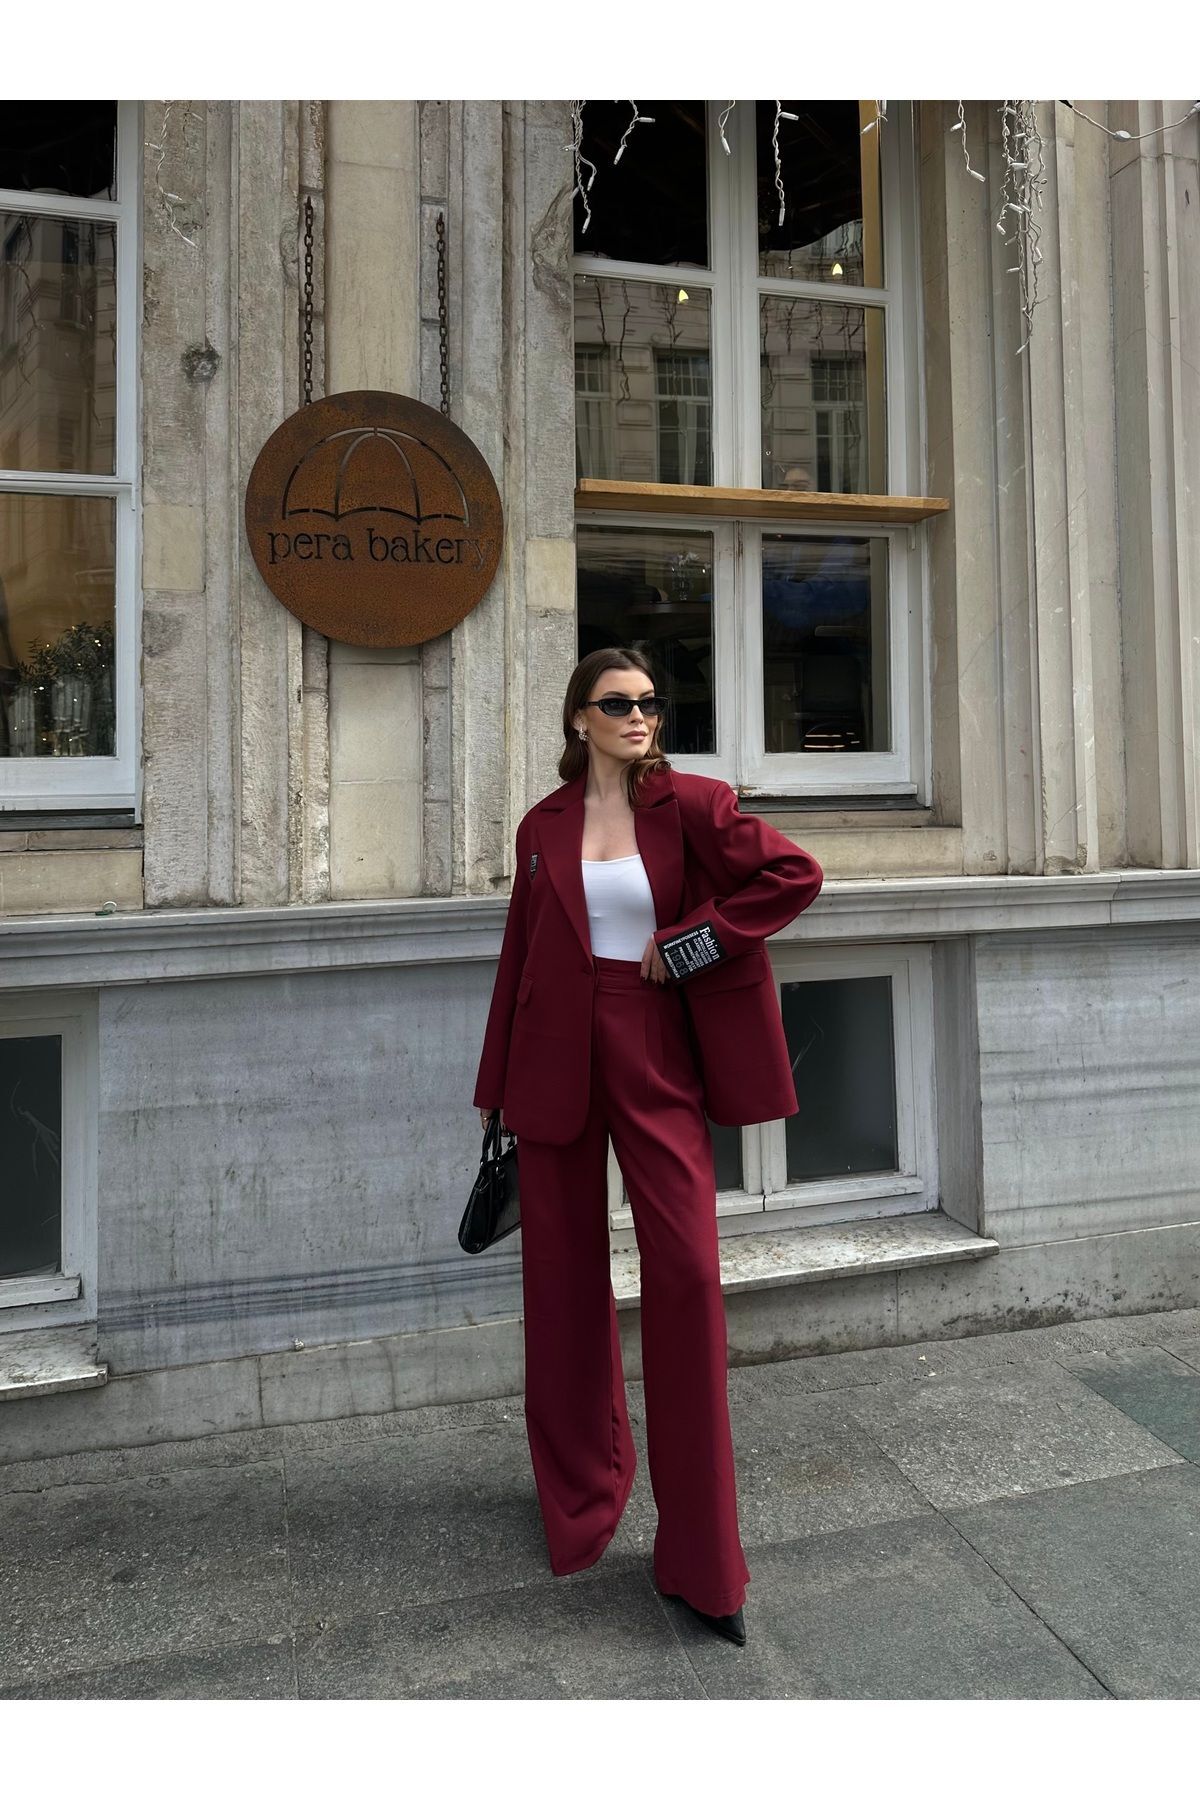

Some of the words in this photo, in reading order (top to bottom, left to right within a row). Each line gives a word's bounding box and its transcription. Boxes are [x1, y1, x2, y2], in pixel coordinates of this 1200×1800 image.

[267, 531, 355, 565] pera
[366, 528, 494, 572] bakery
[699, 926, 720, 960] Fashion
[670, 949, 689, 975] 1968
